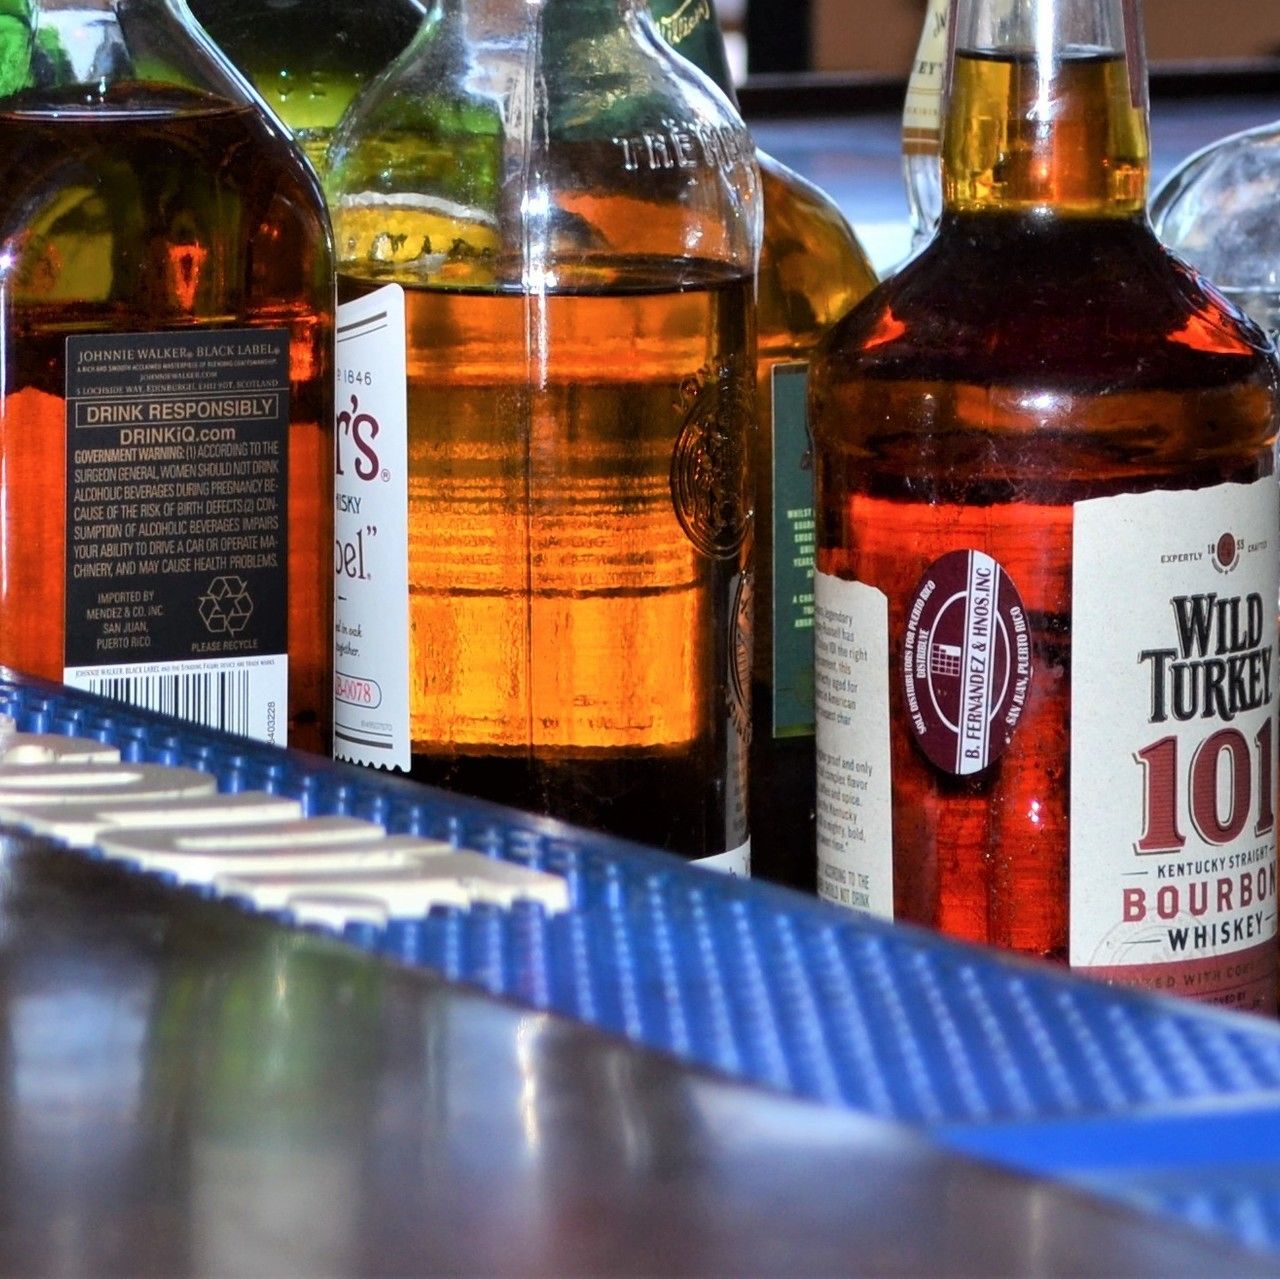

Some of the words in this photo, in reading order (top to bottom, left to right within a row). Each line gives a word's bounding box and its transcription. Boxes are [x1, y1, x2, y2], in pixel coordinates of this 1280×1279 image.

[78, 351, 133, 364] JOHNNIE
[197, 346, 233, 357] BLACK
[344, 370, 372, 385] 1846
[87, 405, 143, 422] DRINK
[149, 399, 273, 420] RESPONSIBLY
[120, 427, 235, 445] DRINKiQ.com
[75, 448, 137, 463] GOVERNMENT
[140, 446, 184, 460] WARNING:
[187, 446, 197, 461] (1)
[198, 444, 247, 458] ACCORDING
[250, 443, 260, 455] TO
[262, 441, 278, 454] THE
[75, 468, 116, 483] SURGEON
[119, 466, 159, 480] GENERAL,
[161, 465, 196, 478] WOMEN
[199, 463, 231, 477] SHOULD
[234, 462, 251, 474] NOT
[253, 460, 278, 474] DRINK
[74, 486, 123, 502] ALCOHOLIC
[125, 484, 174, 499] BEVERAGES
[176, 482, 209, 497] DURING
[211, 480, 262, 495] PREGNANCY
[264, 479, 278, 492] BE-
[74, 507, 104, 521] CAUSE
[107, 506, 119, 519] OF
[122, 505, 137, 519] THE
[140, 504, 160, 518] RISK
[163, 503, 175, 516] OF
[177, 501, 203, 516] BIRTH
[257, 498, 278, 511] CON-
[74, 524, 122, 540] SUMPTION
[125, 524, 136, 537] OF
[140, 521, 187, 536] ALCOHOLIC
[190, 518, 239, 534] BEVERAGES
[242, 516, 278, 530] IMPAIRS
[73, 545, 98, 559] YOUR
[101, 543, 133, 557] ABILITY
[136, 542, 147, 556] TO
[150, 540, 175, 555] DRIVE
[177, 539, 184, 553] A
[186, 538, 205, 553] CAR
[206, 538, 218, 551] OR
[220, 536, 258, 550] OPERATE
[260, 535, 278, 548] MA-
[1160, 552, 1203, 564] EXPERTLY
[73, 563, 114, 578] CHINERY,
[116, 561, 136, 575] AND
[140, 560, 159, 574] MAY
[162, 558, 191, 572] CAUSE
[194, 556, 226, 571] HEALTH
[230, 554, 278, 569] PROBLEMS.
[98, 592, 141, 604] IMPORTED
[143, 591, 154, 602] BY
[920, 580, 936, 601] RICO
[87, 608, 122, 620] MENDEZ
[124, 608, 130, 618] &
[132, 606, 145, 618] CO.
[1009, 606, 1026, 632] RICO
[103, 623, 120, 634] SAN
[123, 622, 148, 634] JUAN,
[1170, 592, 1263, 659] WILD
[97, 638, 129, 650] PUERTO
[191, 642, 220, 652] PLEASE
[223, 639, 258, 650] RECYCLE
[972, 643, 986, 655] &
[1017, 633, 1029, 674] PUERTO
[1137, 645, 1272, 724] TURKEY
[966, 658, 985, 740] FERNANDEZ
[1005, 704, 1021, 726] SAN
[965, 745, 980, 759] B.
[1131, 716, 1275, 856] 101
[1157, 857, 1226, 879] KENTUCKY
[1228, 845, 1269, 869] STRAIGHT
[1122, 859, 1277, 923] BOURBON
[1168, 911, 1264, 952] WHISKEY
